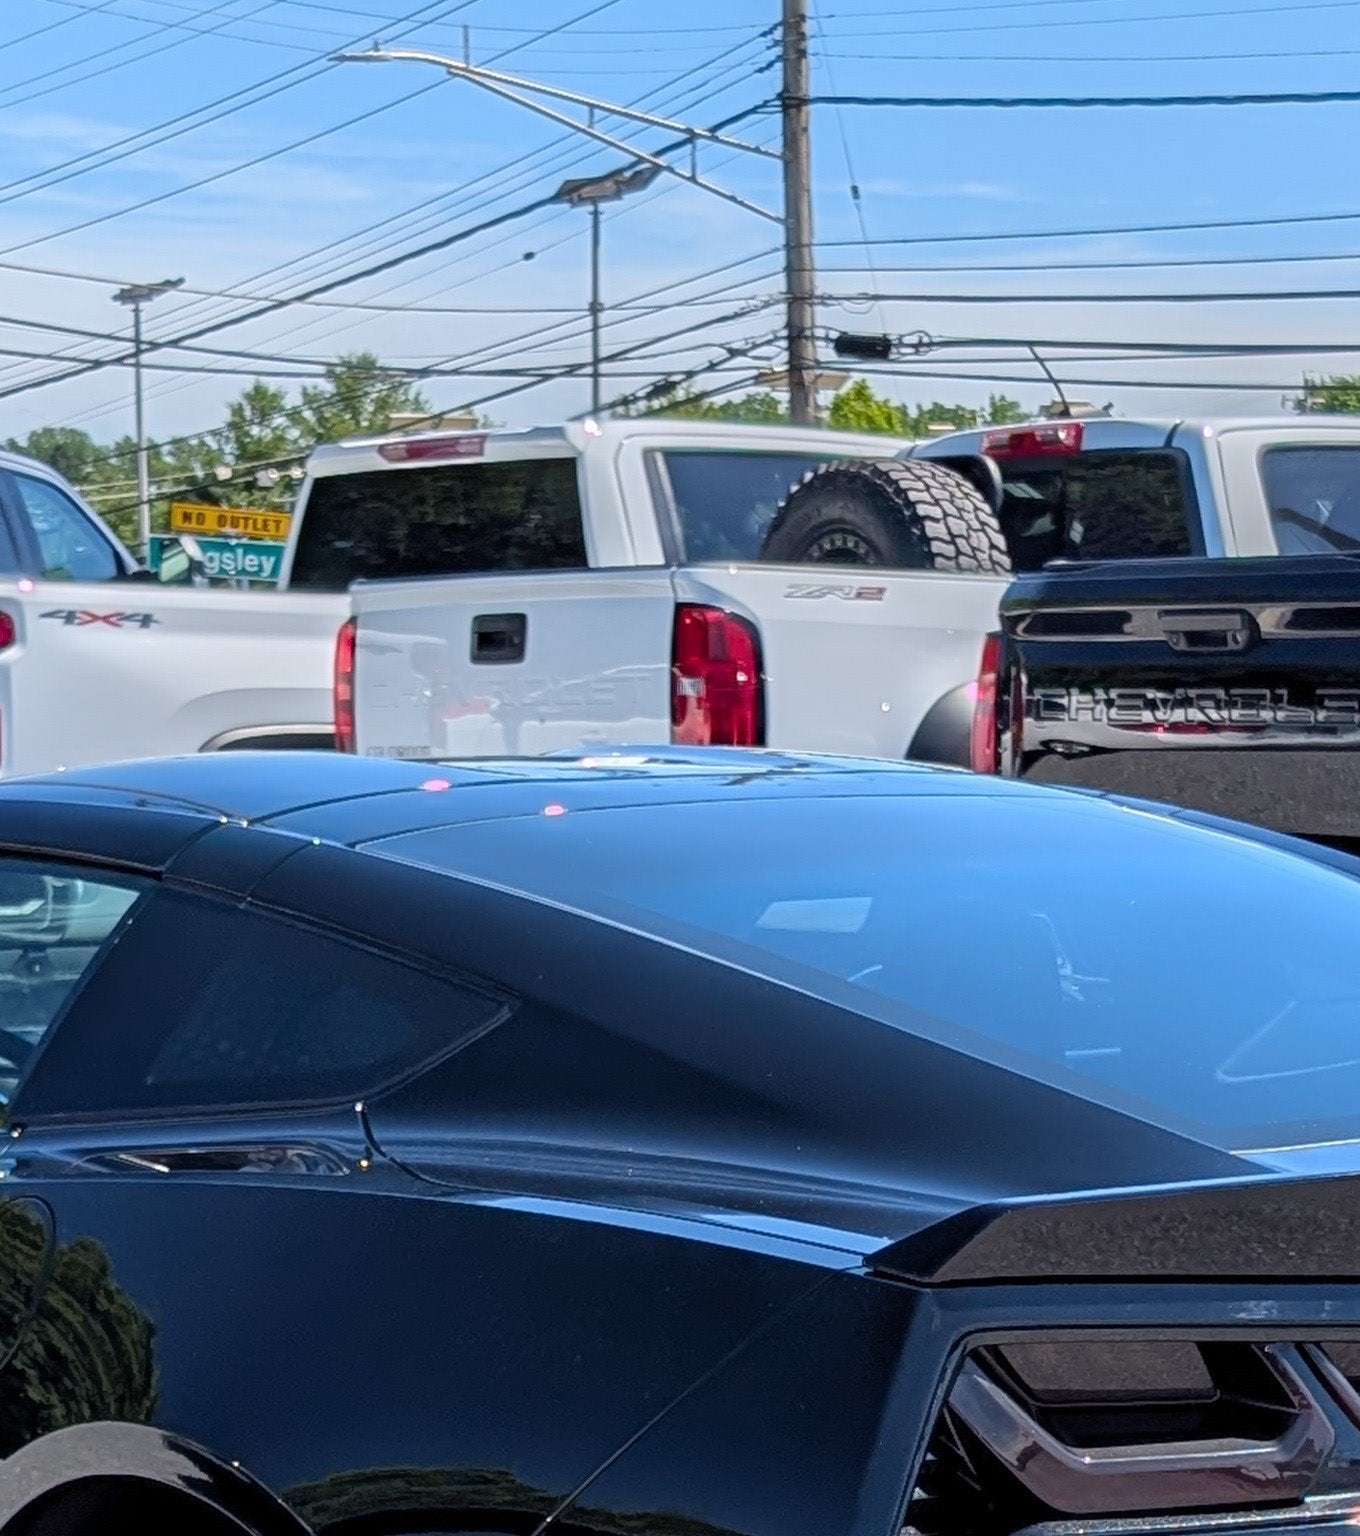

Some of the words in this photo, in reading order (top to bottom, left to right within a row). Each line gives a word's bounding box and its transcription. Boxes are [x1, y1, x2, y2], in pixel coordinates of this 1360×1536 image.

[181, 510, 206, 526] NO
[217, 513, 283, 533] OUTLET
[203, 547, 276, 578] gsley
